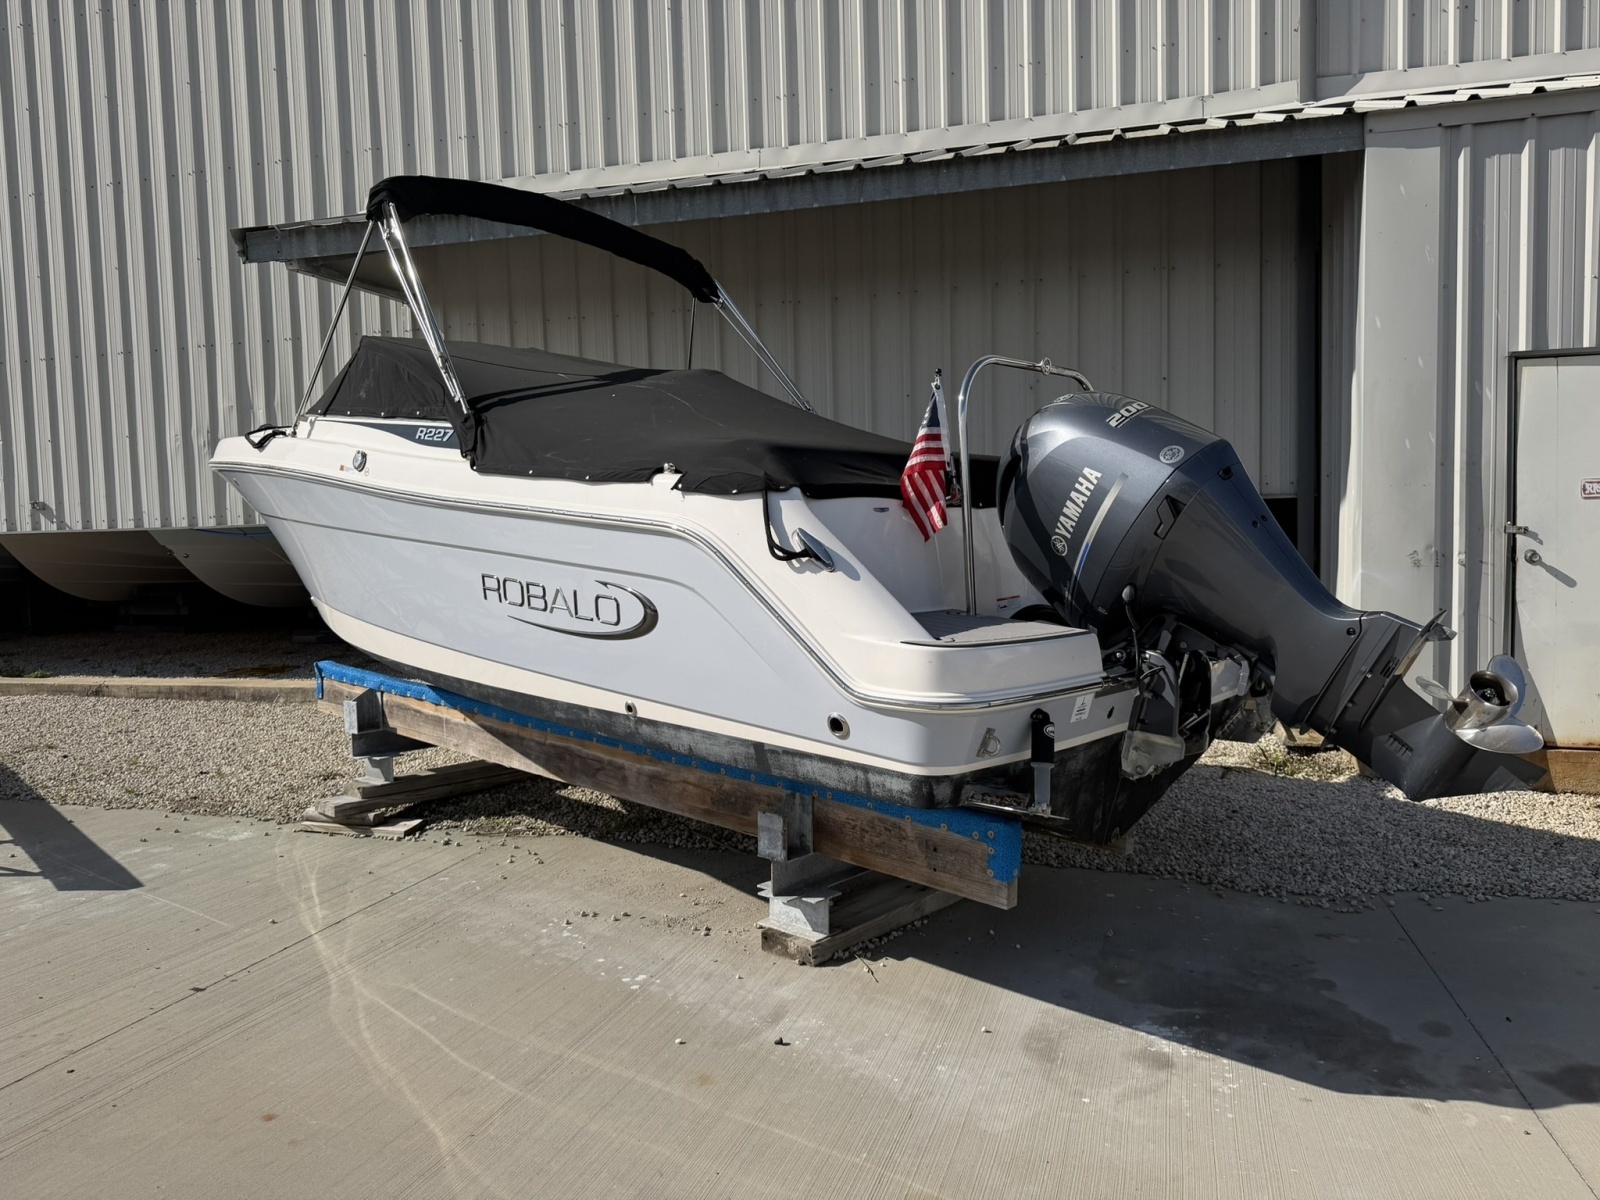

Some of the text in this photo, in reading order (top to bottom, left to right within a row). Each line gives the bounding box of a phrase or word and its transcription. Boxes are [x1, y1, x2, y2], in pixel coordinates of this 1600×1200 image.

[1106, 401, 1149, 427] 200
[415, 427, 454, 442] R227
[1054, 466, 1102, 539] YAMAHA
[481, 573, 621, 626] ROBALO
